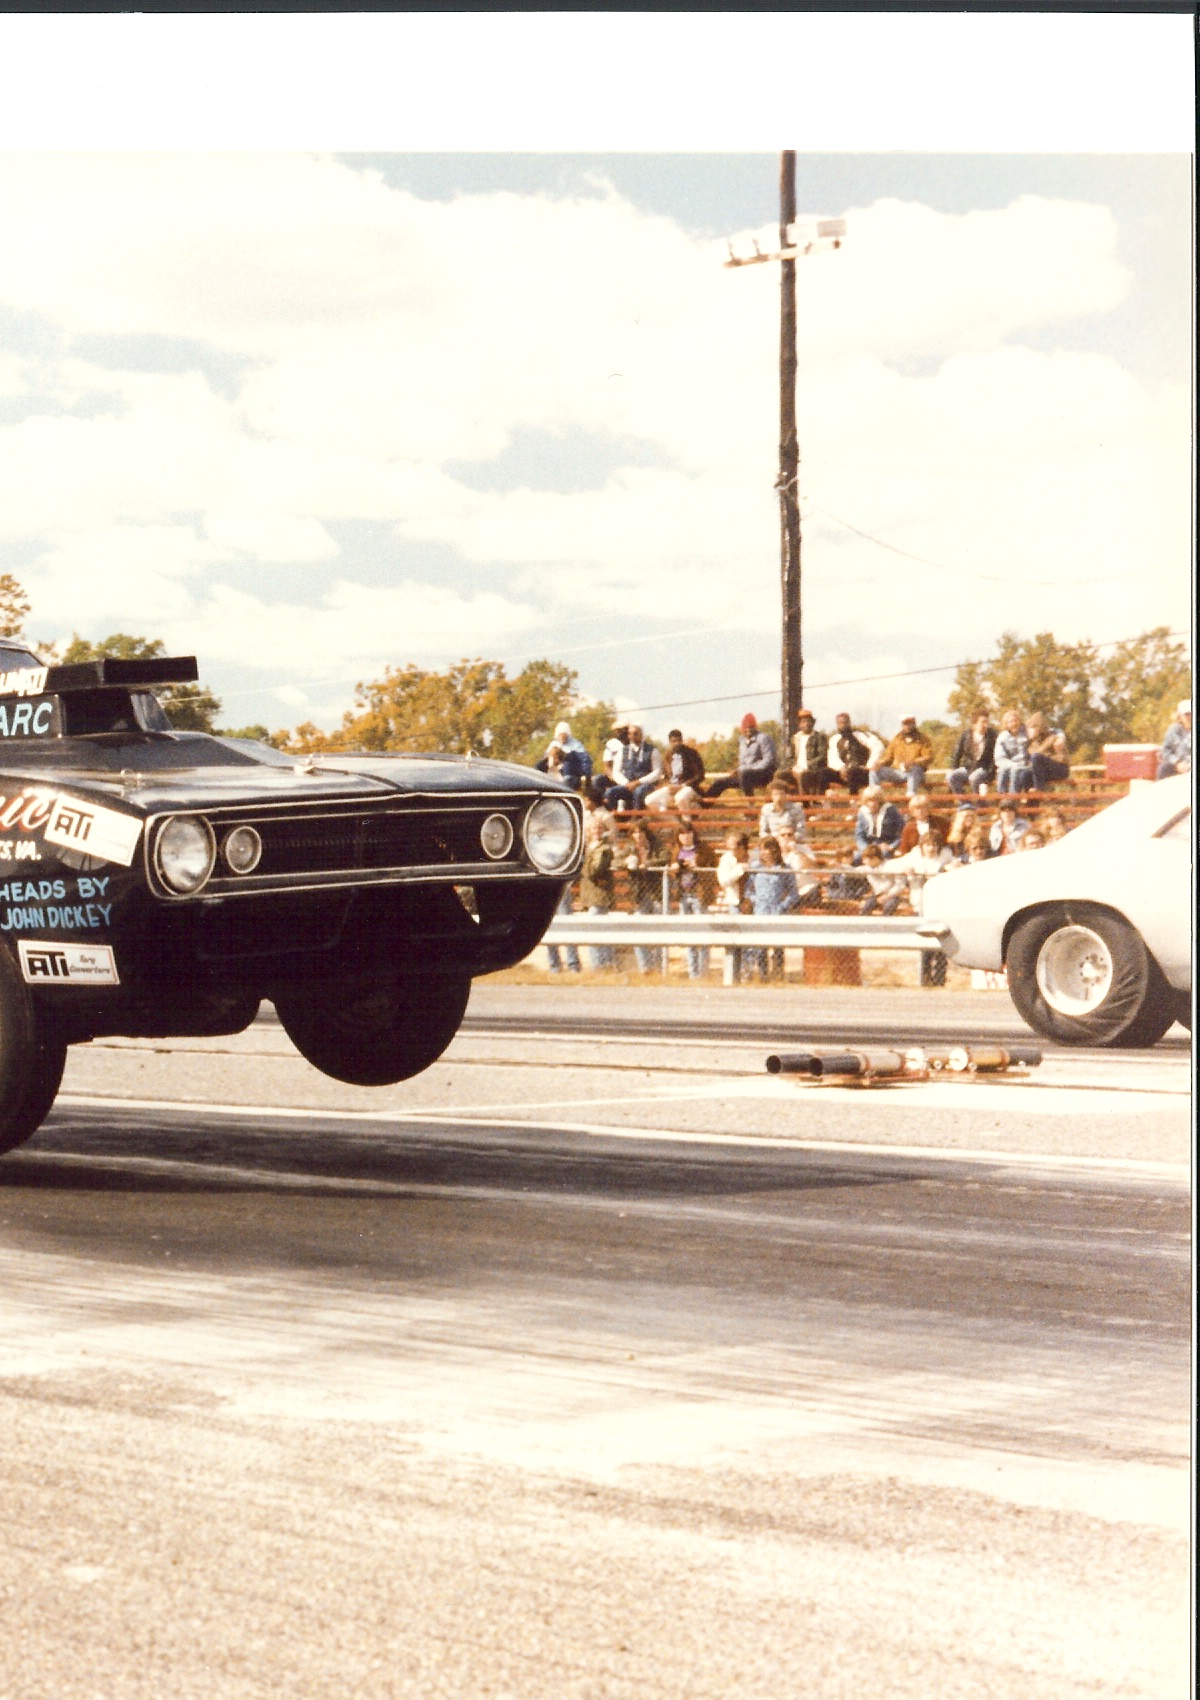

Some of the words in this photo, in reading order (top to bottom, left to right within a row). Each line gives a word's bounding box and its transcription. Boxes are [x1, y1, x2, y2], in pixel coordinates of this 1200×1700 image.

[54, 806, 94, 841] ATI
[77, 876, 110, 898] BY
[0, 907, 46, 931] JOHN
[46, 903, 112, 929] DICKEY
[26, 950, 70, 977] ATI
